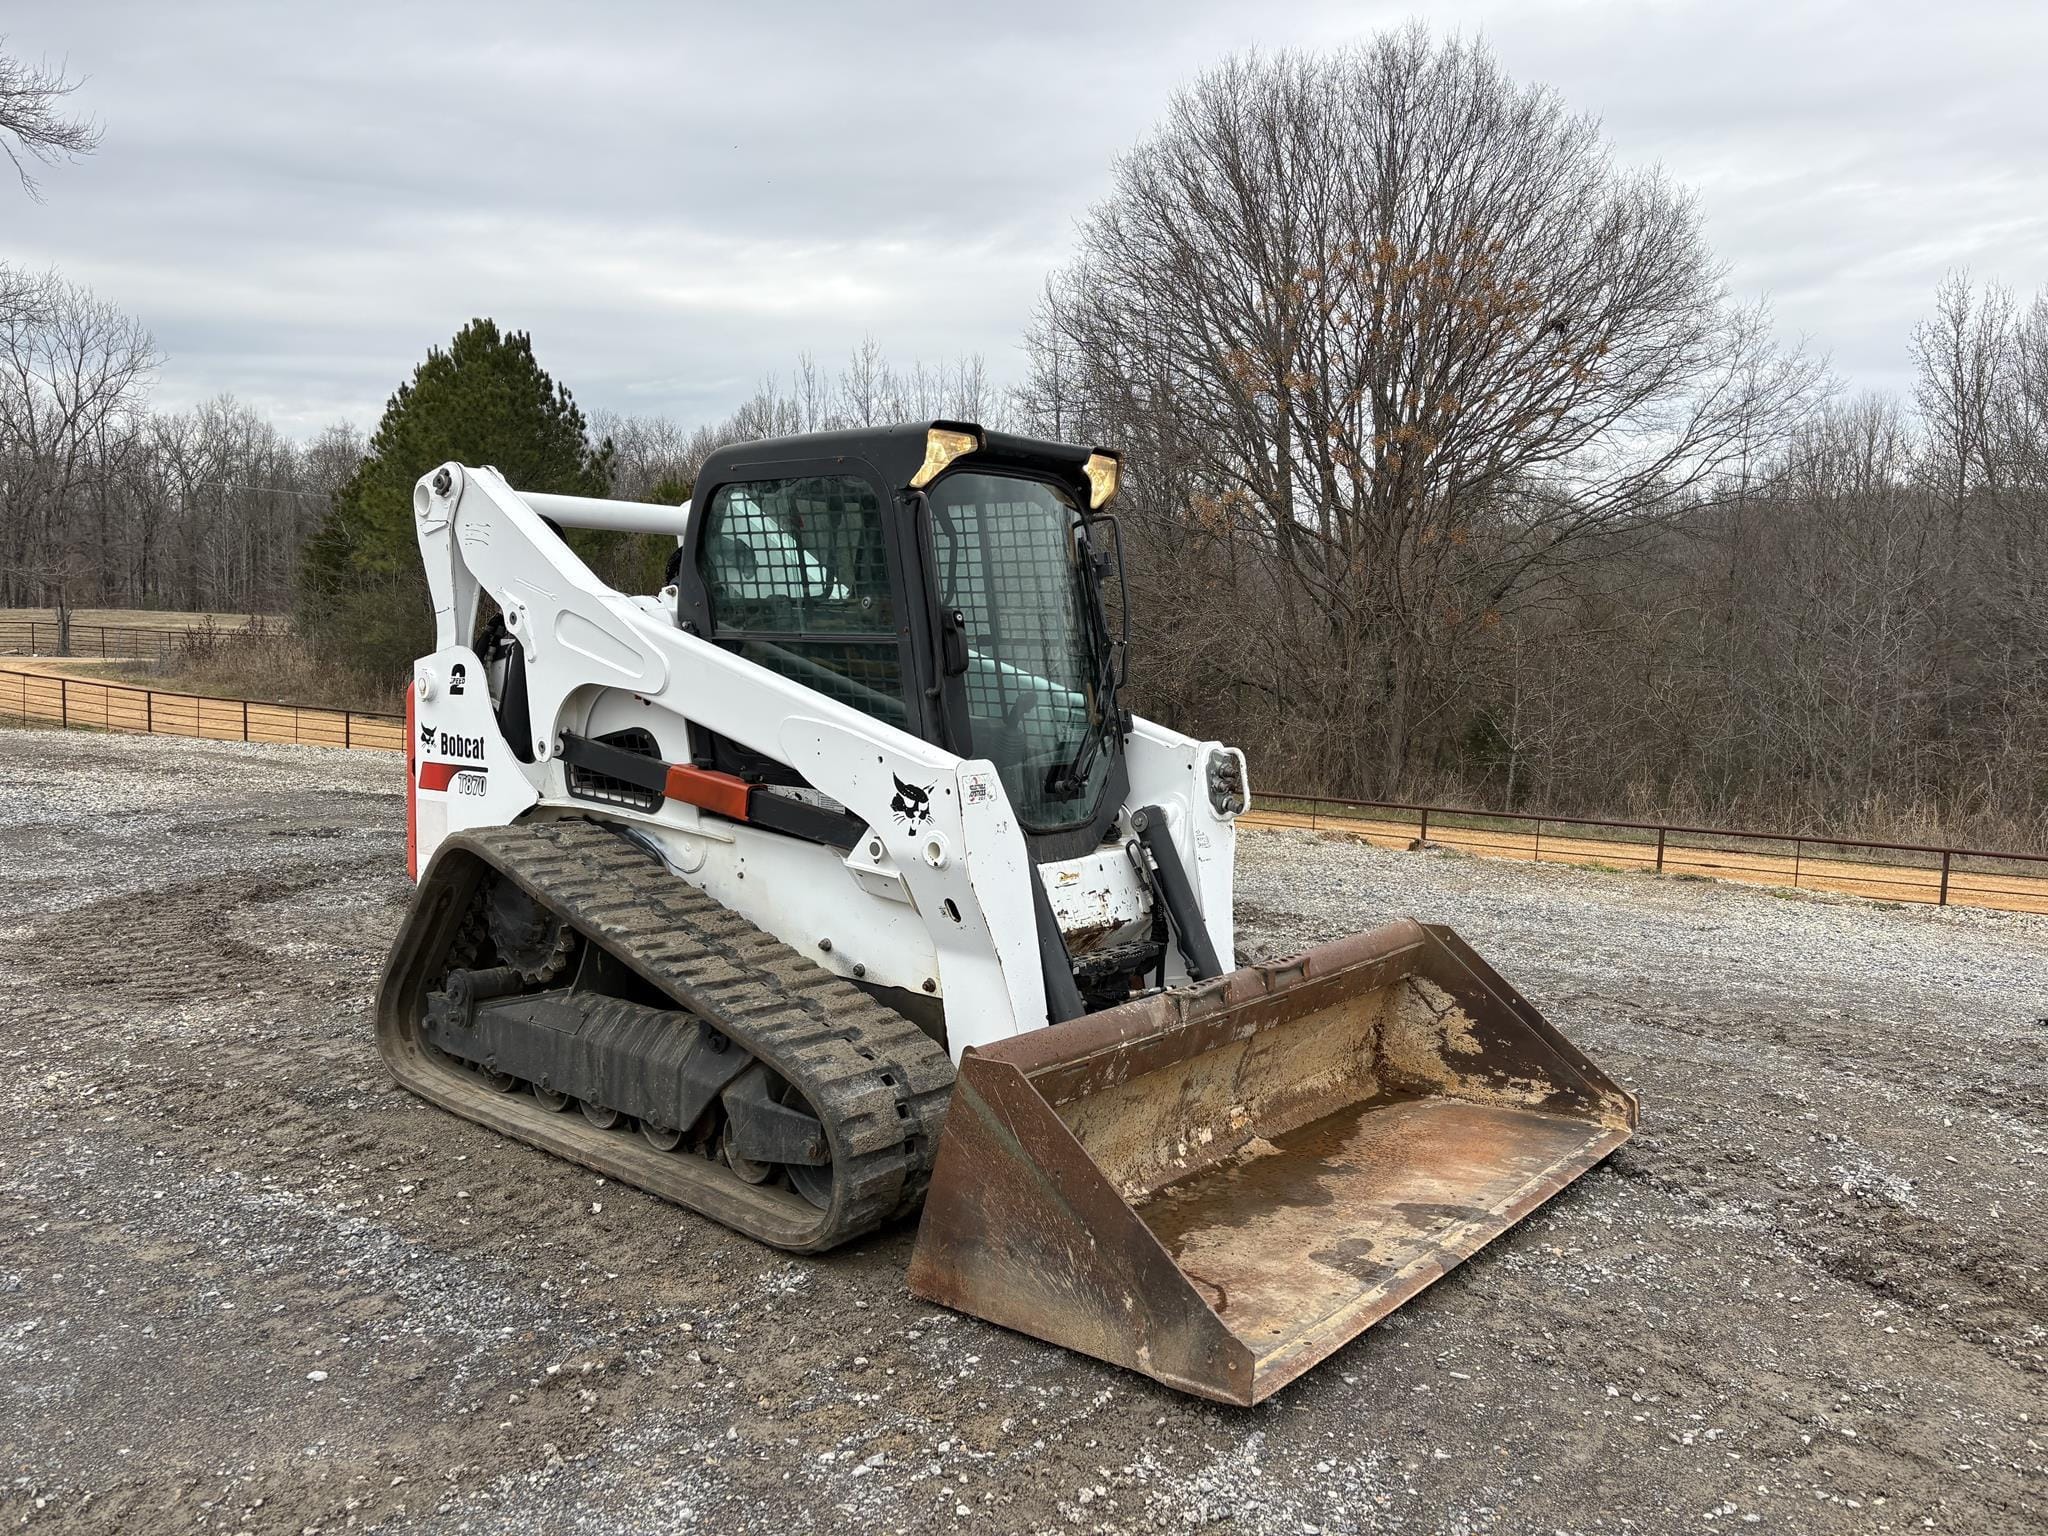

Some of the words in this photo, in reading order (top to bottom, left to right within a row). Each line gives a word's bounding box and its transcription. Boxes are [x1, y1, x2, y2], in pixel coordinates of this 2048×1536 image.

[449, 663, 466, 695] 2
[440, 732, 485, 760] Bobcat
[458, 773, 487, 796] T870
